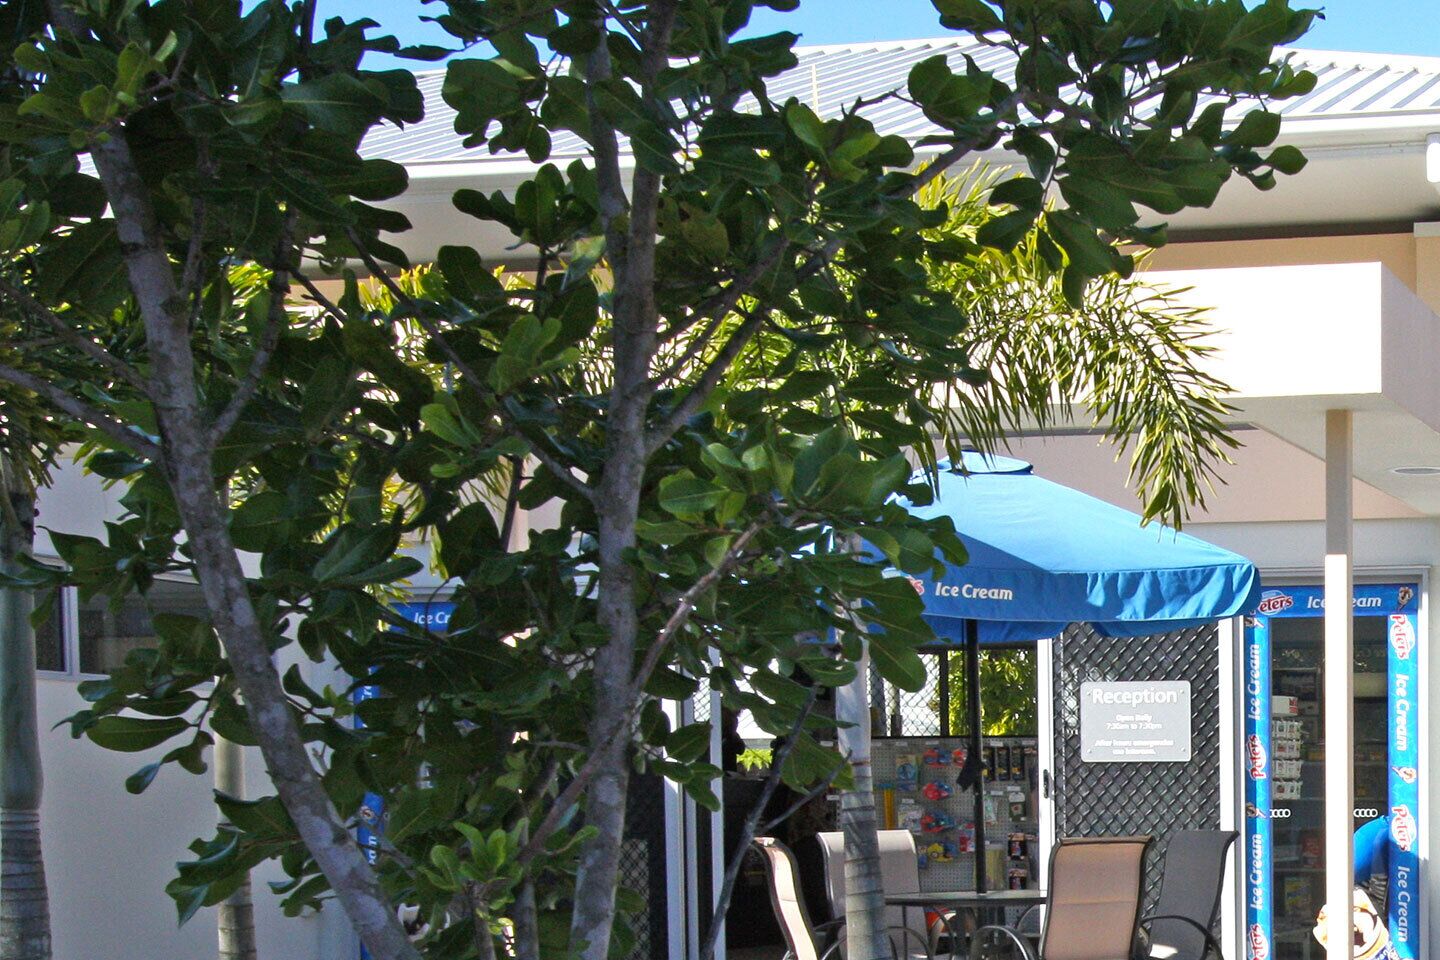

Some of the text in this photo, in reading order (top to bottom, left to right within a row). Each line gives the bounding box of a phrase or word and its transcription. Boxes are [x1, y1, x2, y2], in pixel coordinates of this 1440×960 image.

[935, 582, 958, 596] Ice
[962, 584, 1013, 600] Cream
[1258, 596, 1293, 612] eters
[1093, 687, 1178, 708] Reception
[1391, 615, 1410, 751] Peters Ice Cream
[1248, 644, 1266, 779] Peters Ice Cream
[1392, 805, 1410, 852] Peters
[1250, 833, 1263, 886] Cream
[1398, 866, 1410, 887] Ice
[1251, 888, 1263, 910] Ice
[1398, 889, 1410, 942] Cream
